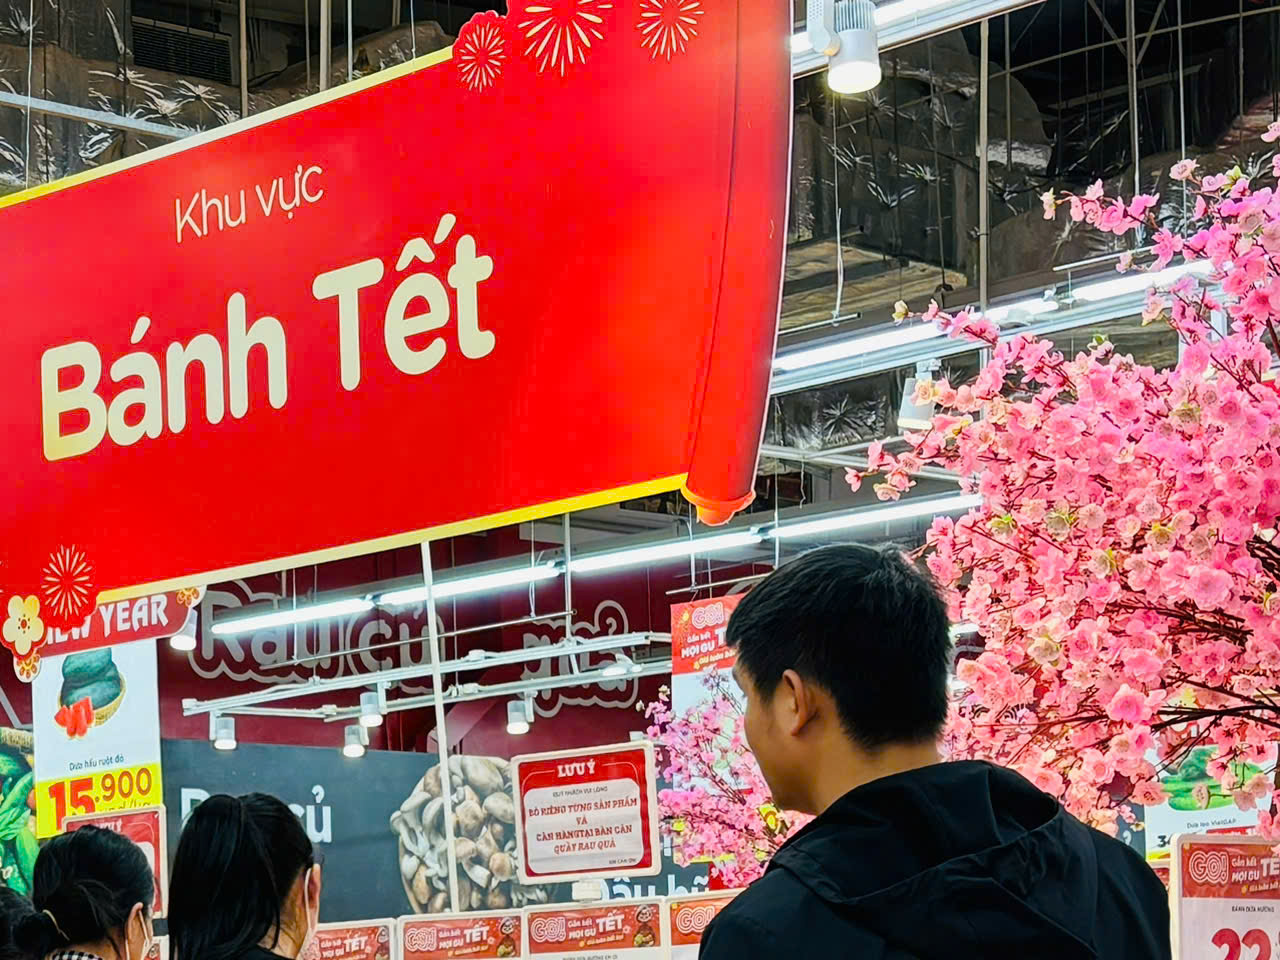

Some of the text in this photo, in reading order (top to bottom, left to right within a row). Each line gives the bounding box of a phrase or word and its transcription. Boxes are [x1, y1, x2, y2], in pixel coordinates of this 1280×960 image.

[176, 165, 324, 243] Khu vực
[41, 214, 495, 460] Bánh Tết
[99, 593, 169, 638] YEAR
[557, 759, 596, 778] LƯU Ý
[578, 842, 596, 852] RAU
[1189, 850, 1229, 885] GO!
[1231, 870, 1260, 883] MỌI GU
[463, 920, 490, 944] TẾT
[530, 917, 567, 943] GO!
[584, 928, 596, 937] GU
[595, 908, 625, 933] TẾT
[343, 932, 369, 953] TẾT
[405, 926, 437, 952] GO!
